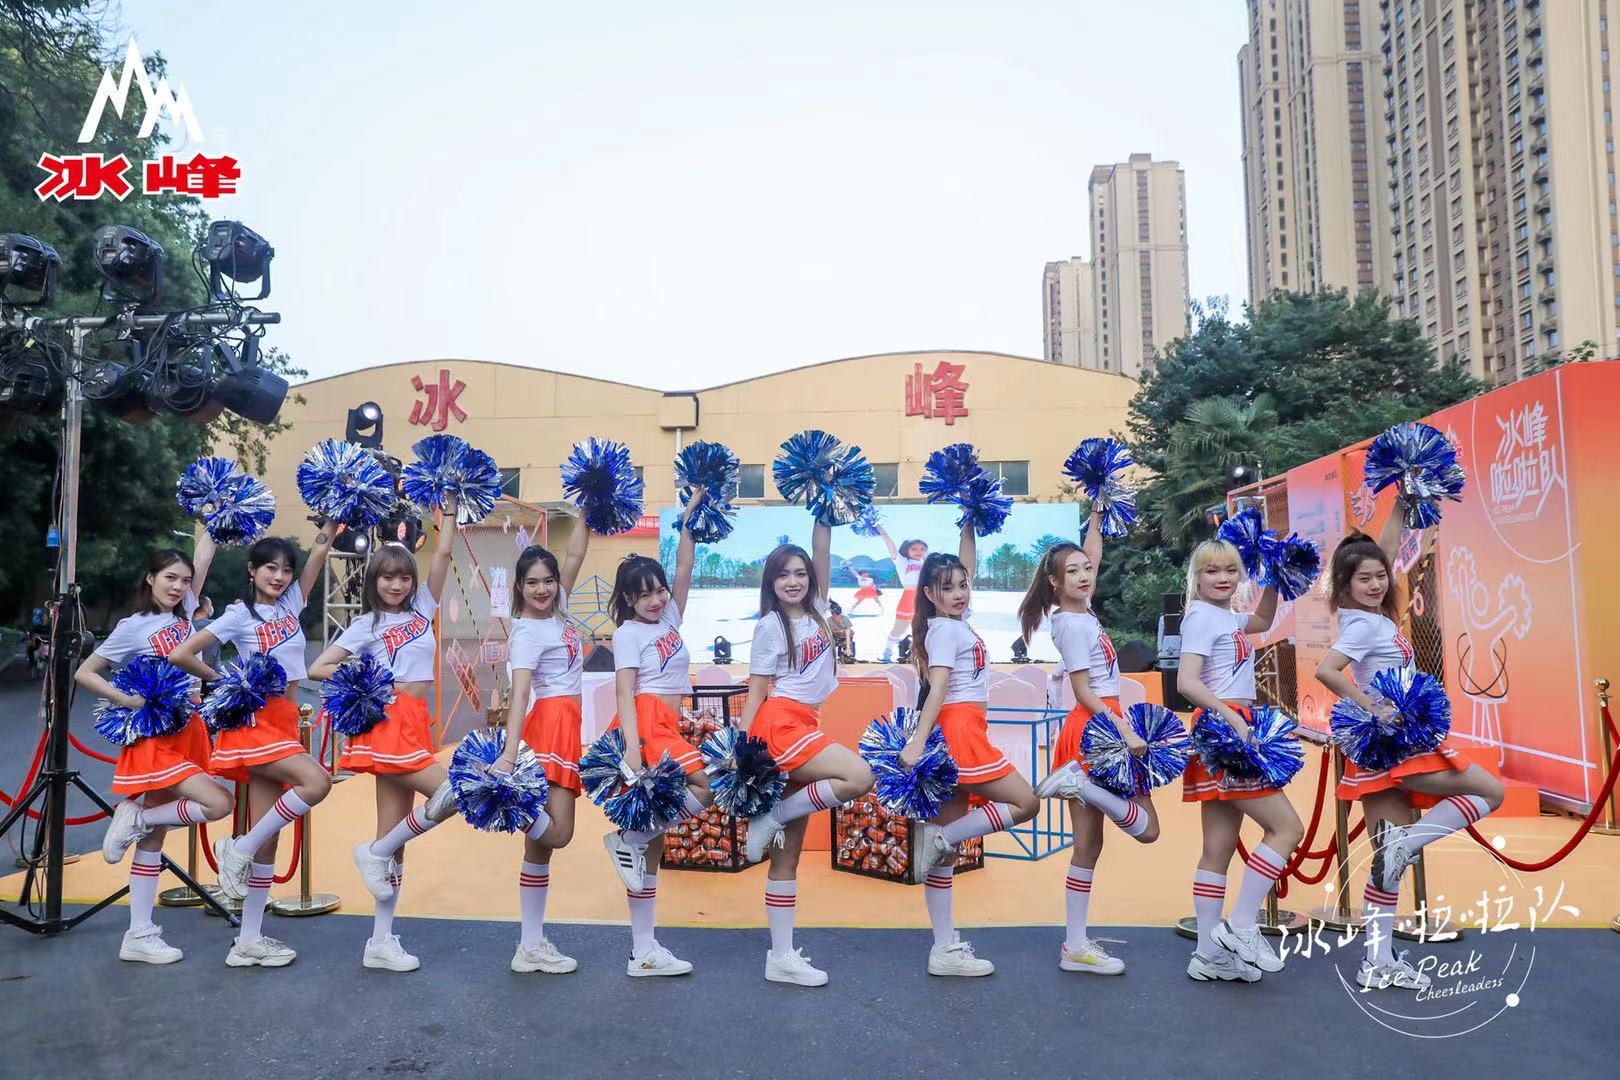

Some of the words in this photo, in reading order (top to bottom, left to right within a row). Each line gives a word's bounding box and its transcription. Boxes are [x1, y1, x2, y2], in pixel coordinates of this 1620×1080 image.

[408, 369, 468, 431] 冰
[905, 360, 971, 425] 峰
[1496, 400, 1548, 466] 冰峰
[1490, 444, 1565, 518] 啦啦队
